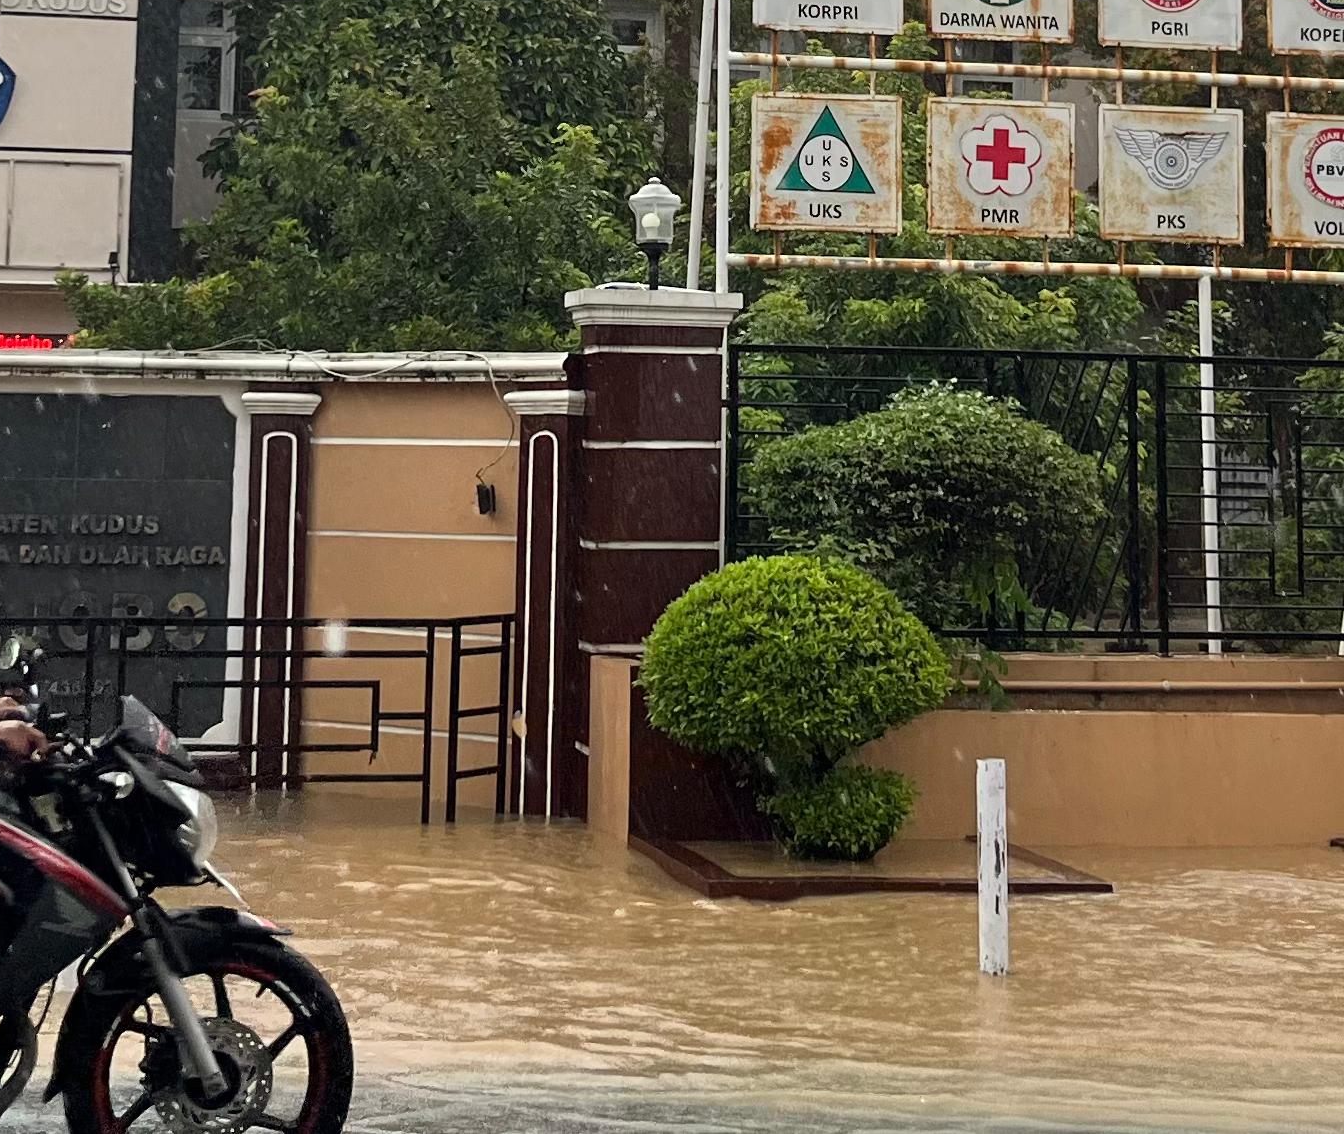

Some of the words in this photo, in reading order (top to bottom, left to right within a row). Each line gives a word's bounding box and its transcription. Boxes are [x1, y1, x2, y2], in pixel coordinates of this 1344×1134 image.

[797, 3, 858, 20] KORPRI
[939, 12, 996, 28] DARMA
[1000, 14, 1059, 31] WANITA
[1151, 21, 1189, 37] PGRI
[809, 203, 843, 219] UKS
[981, 209, 1020, 224] PMR
[1157, 214, 1186, 230] PKS
[71, 514, 160, 535] KUDUS
[19, 544, 71, 565] DAN
[80, 545, 149, 565] OLAH
[155, 546, 227, 566] RAGA
